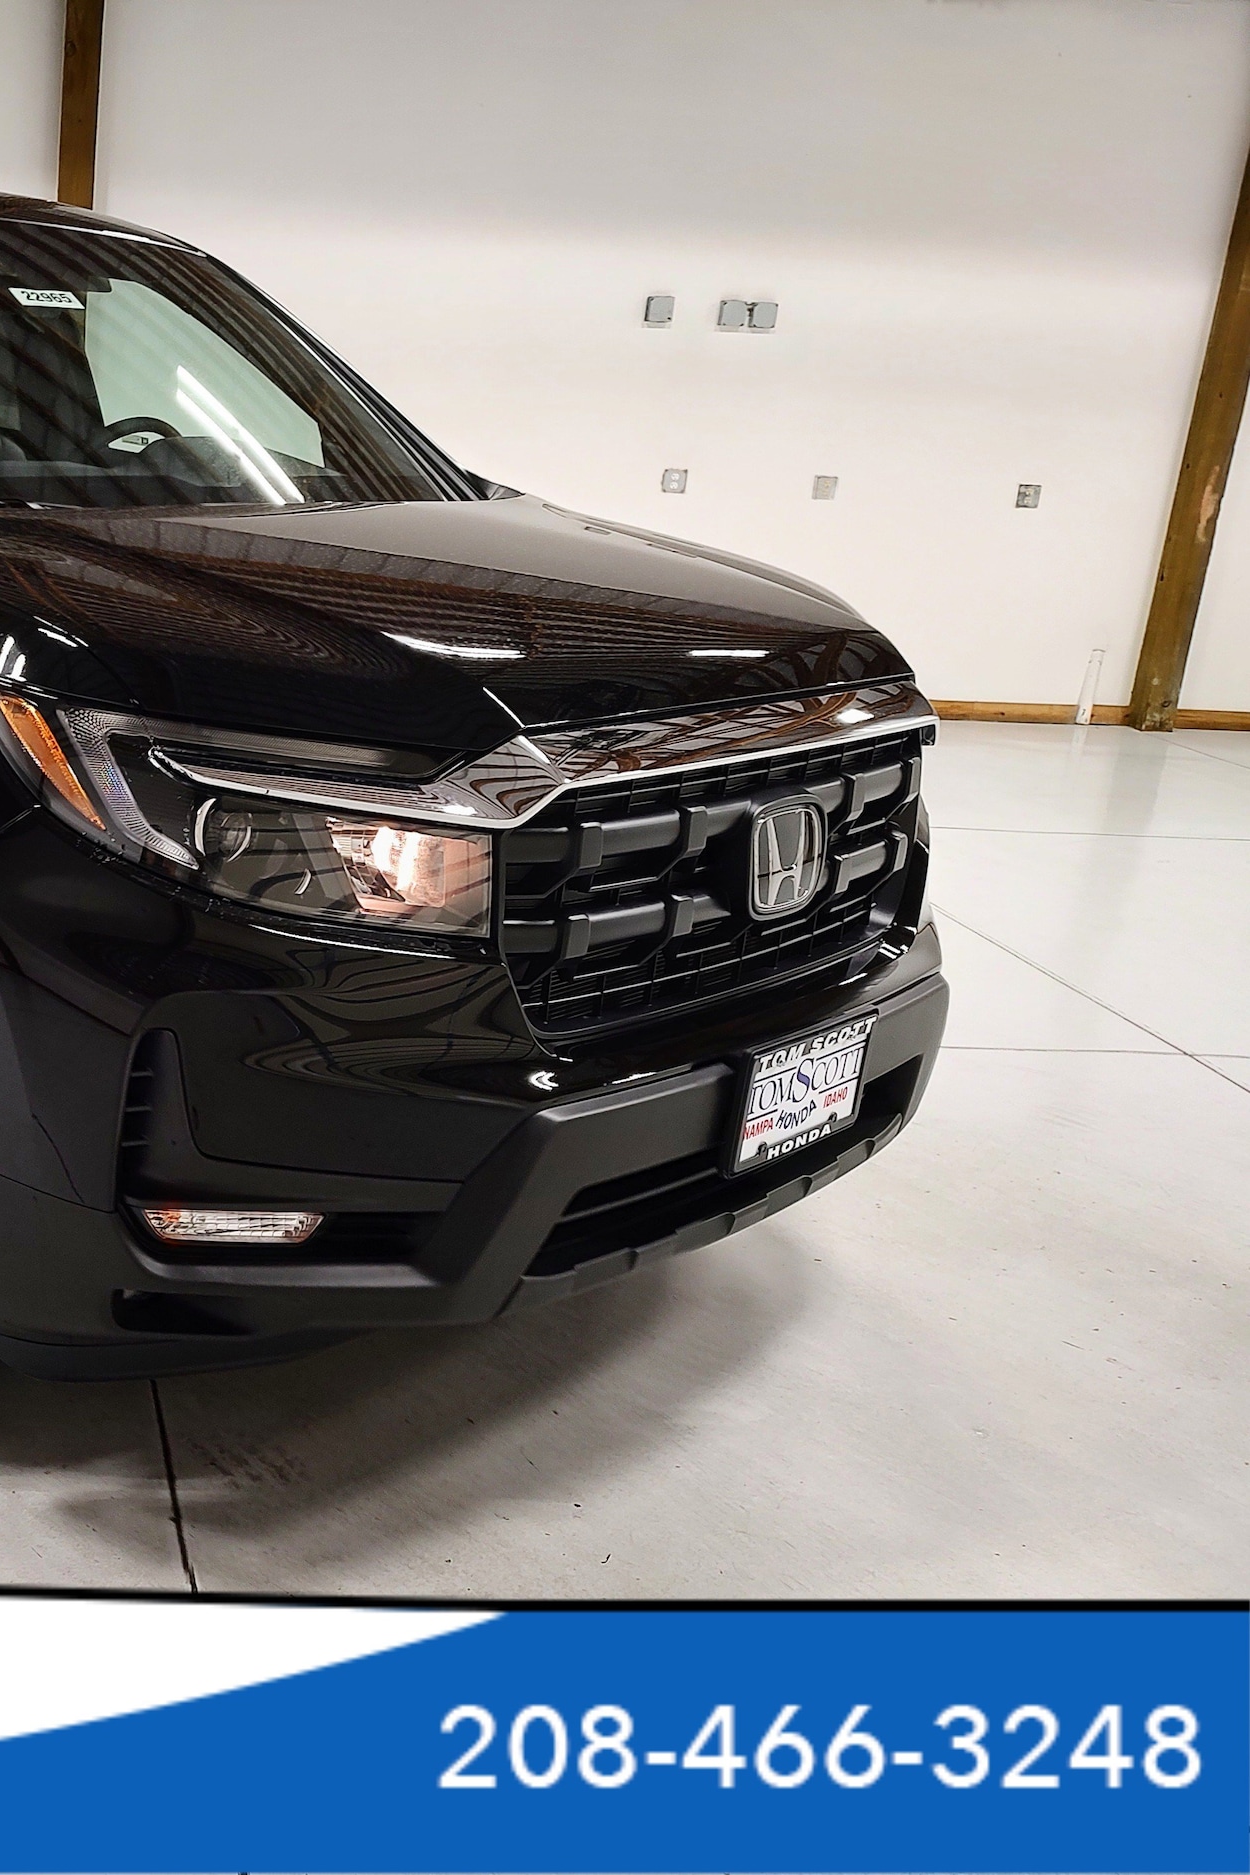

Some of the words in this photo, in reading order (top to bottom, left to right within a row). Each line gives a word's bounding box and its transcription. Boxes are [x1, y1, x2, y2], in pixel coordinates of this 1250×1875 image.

[21, 290, 72, 303] 22965
[759, 1043, 805, 1073] TOM
[809, 1016, 878, 1054] SCOTT
[822, 1087, 848, 1108] IDAHO
[775, 1100, 817, 1130] HONDA
[743, 1118, 773, 1140] NAMPA
[766, 1123, 831, 1160] HONDA
